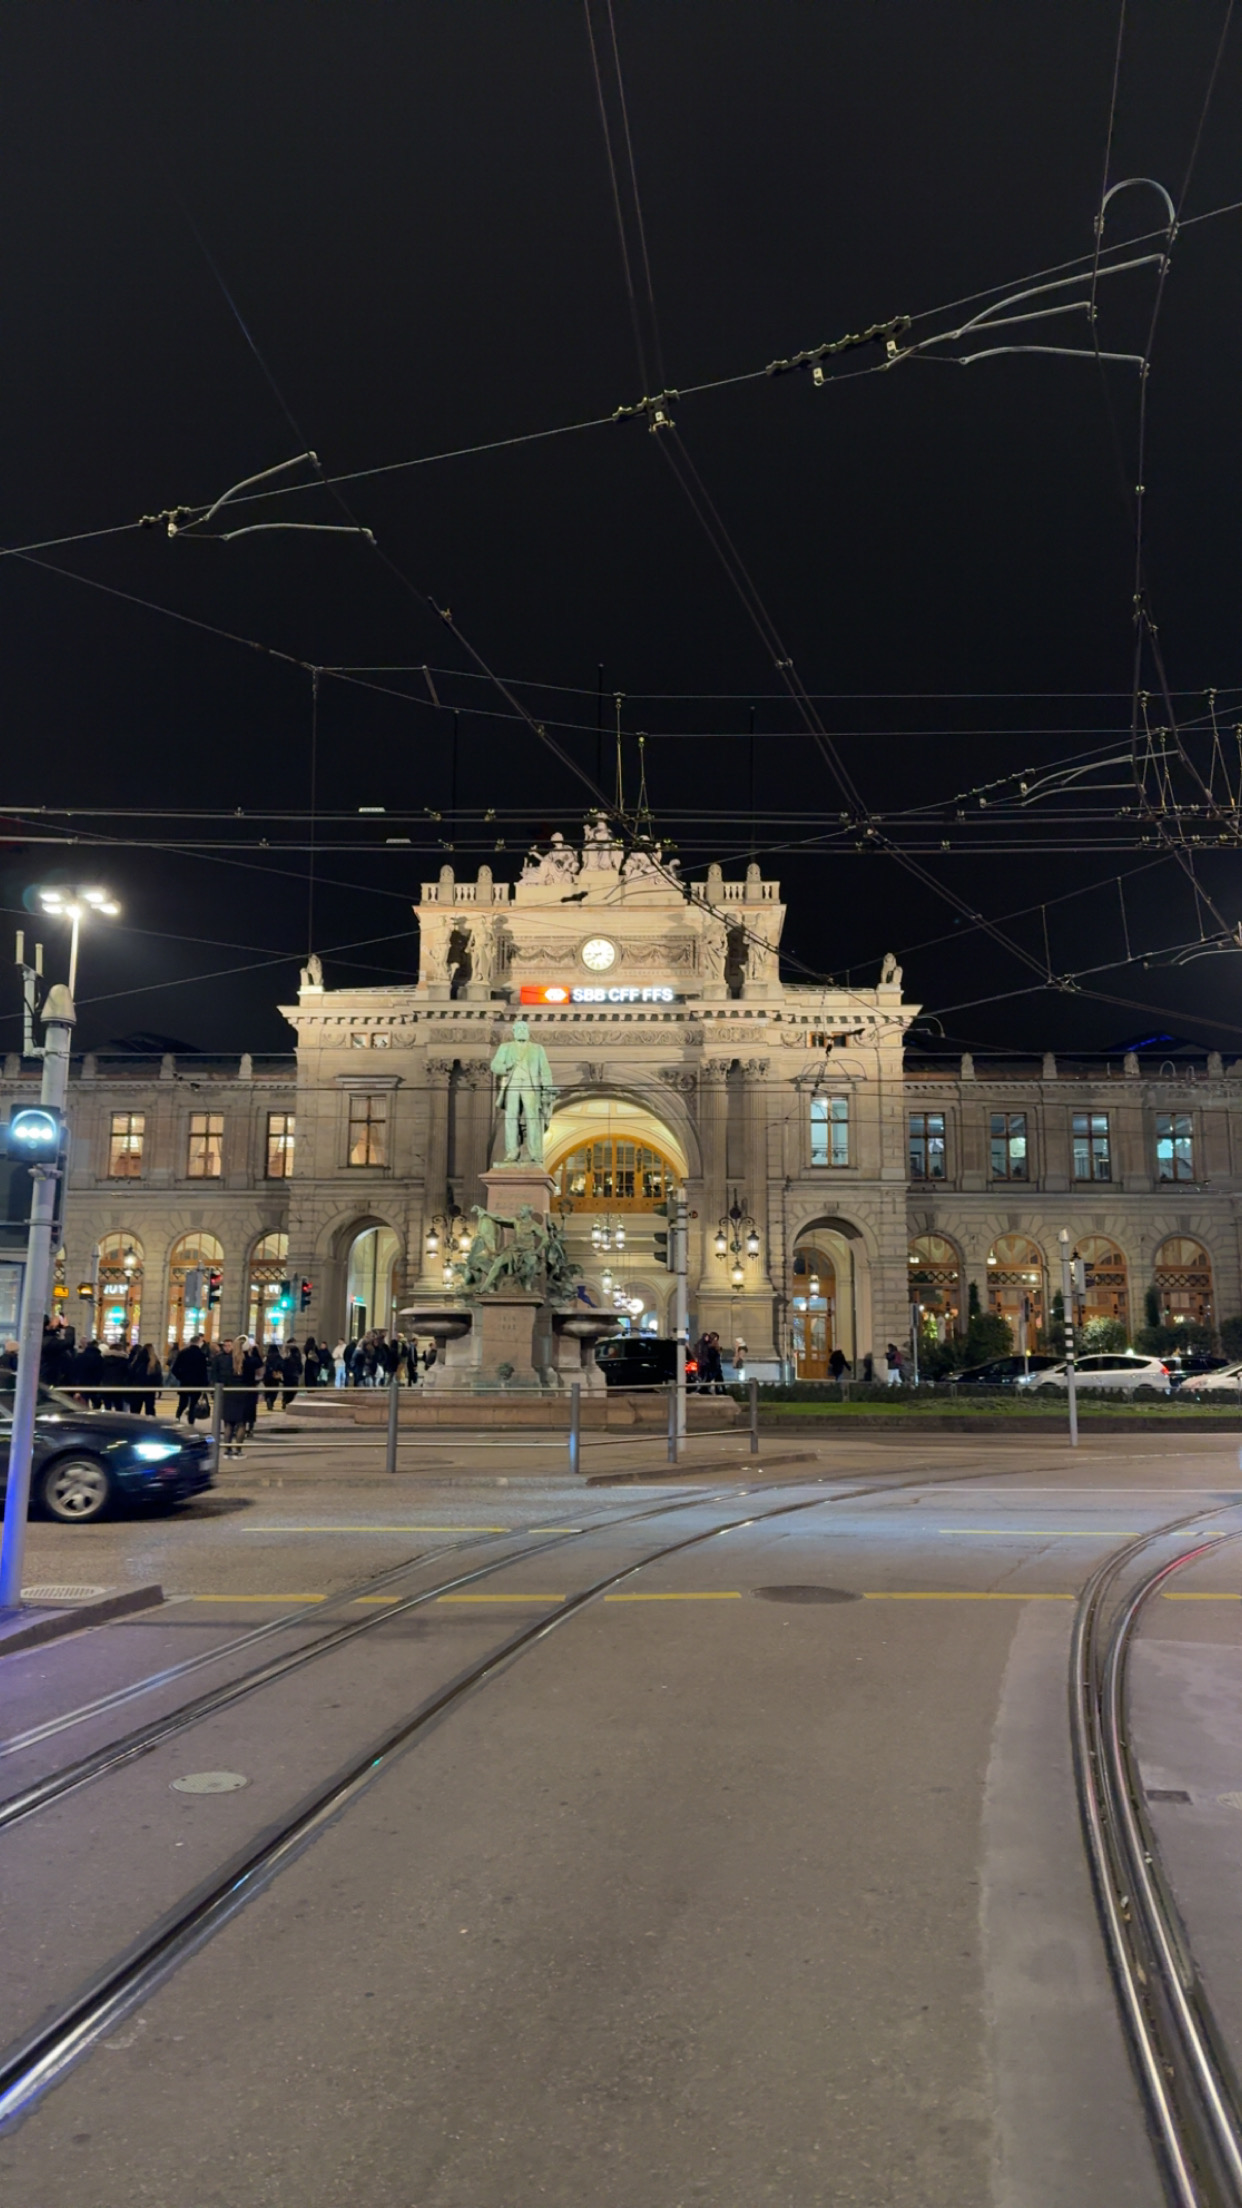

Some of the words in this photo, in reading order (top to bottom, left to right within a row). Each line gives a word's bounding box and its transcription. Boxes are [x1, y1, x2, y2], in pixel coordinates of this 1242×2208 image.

[573, 987, 604, 1001] SBB
[608, 987, 639, 1001] CFF
[642, 987, 673, 1001] FFS
